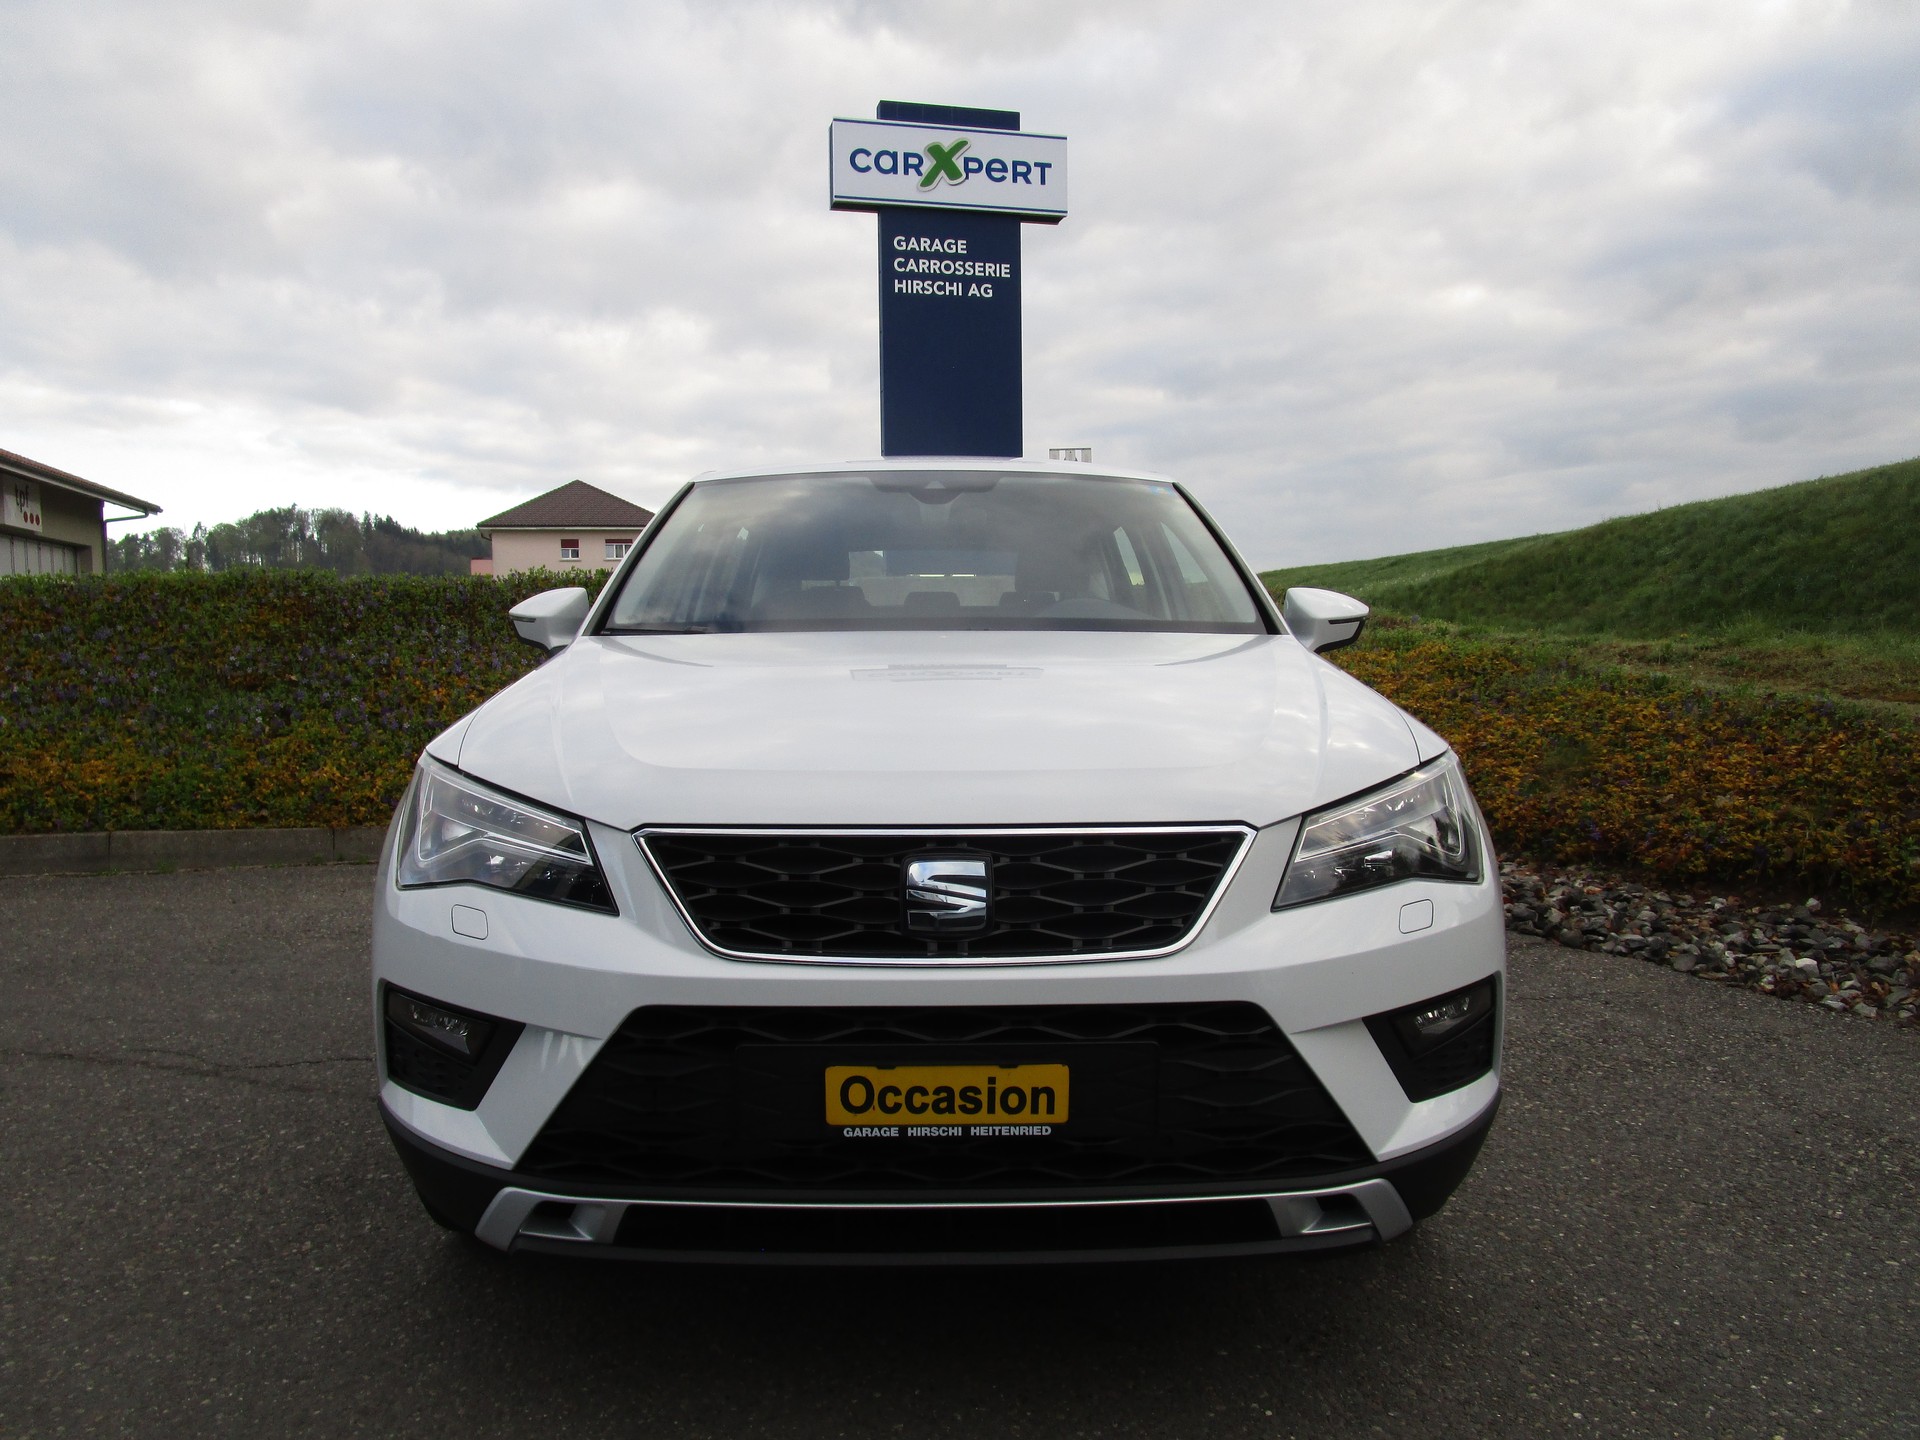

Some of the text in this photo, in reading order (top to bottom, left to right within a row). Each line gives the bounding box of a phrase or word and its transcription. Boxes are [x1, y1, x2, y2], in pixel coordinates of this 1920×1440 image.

[893, 236, 967, 254] GARAGE
[893, 257, 1011, 278] CARROSSERIE
[894, 279, 993, 298] HIRSCHI AG
[840, 1075, 1056, 1115] Occasion
[843, 1125, 1052, 1137] GARAGE HIRSCHI HEITENRIED
